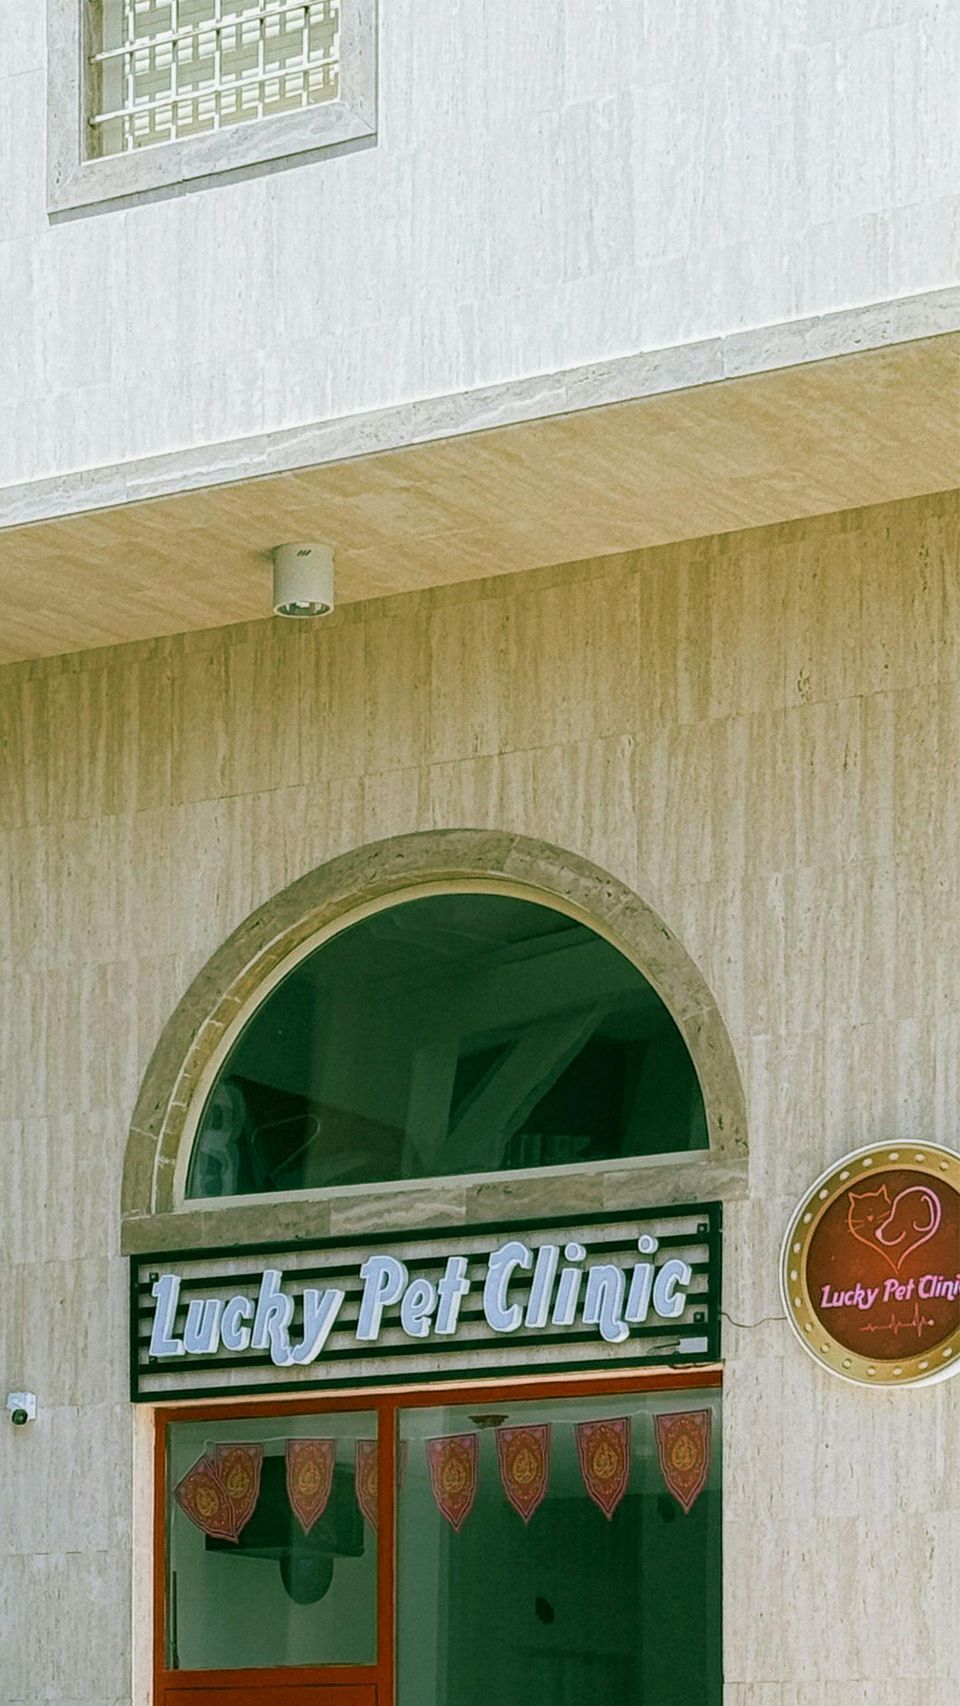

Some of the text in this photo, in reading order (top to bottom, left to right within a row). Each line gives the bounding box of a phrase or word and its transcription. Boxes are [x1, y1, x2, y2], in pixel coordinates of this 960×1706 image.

[147, 1234, 692, 1367] Lucky Pet Clinic
[820, 1273, 960, 1310] Lucky Pet Clini
